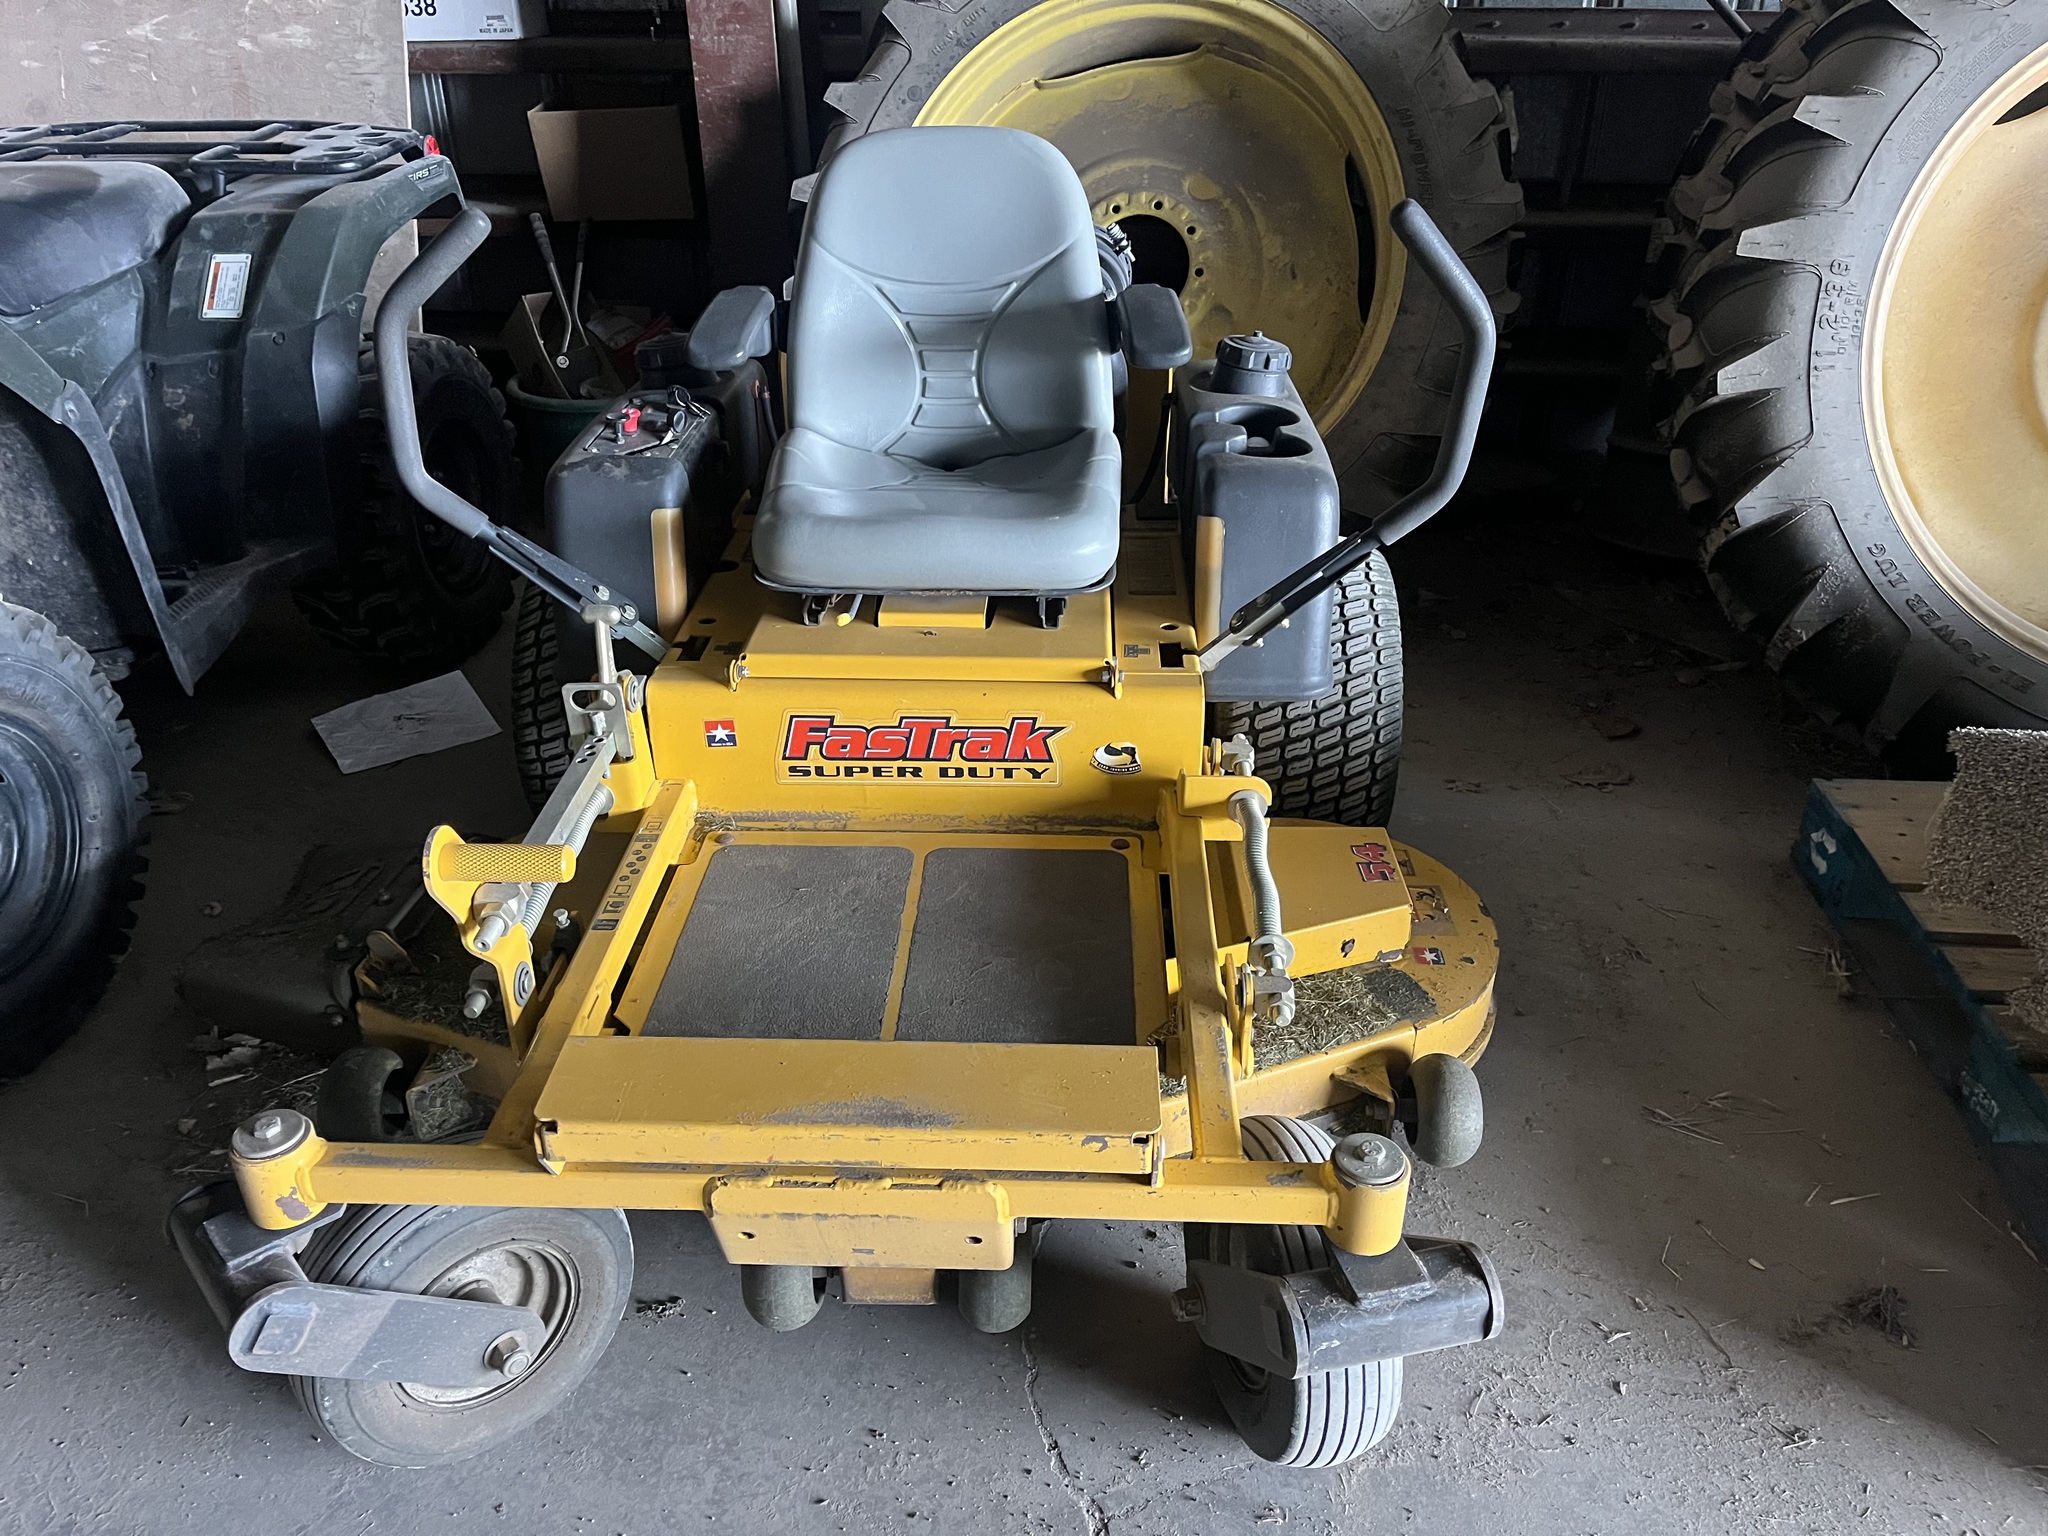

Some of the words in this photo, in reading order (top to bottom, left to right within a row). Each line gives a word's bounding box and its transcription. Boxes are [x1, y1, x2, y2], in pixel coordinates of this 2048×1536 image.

[404, 0, 437, 17] 38
[1867, 543, 1908, 588] LUG
[782, 715, 1067, 763] FasTrak
[788, 765, 923, 778] SUPER
[939, 766, 1051, 779] DUTY
[1351, 843, 1396, 883] 54
